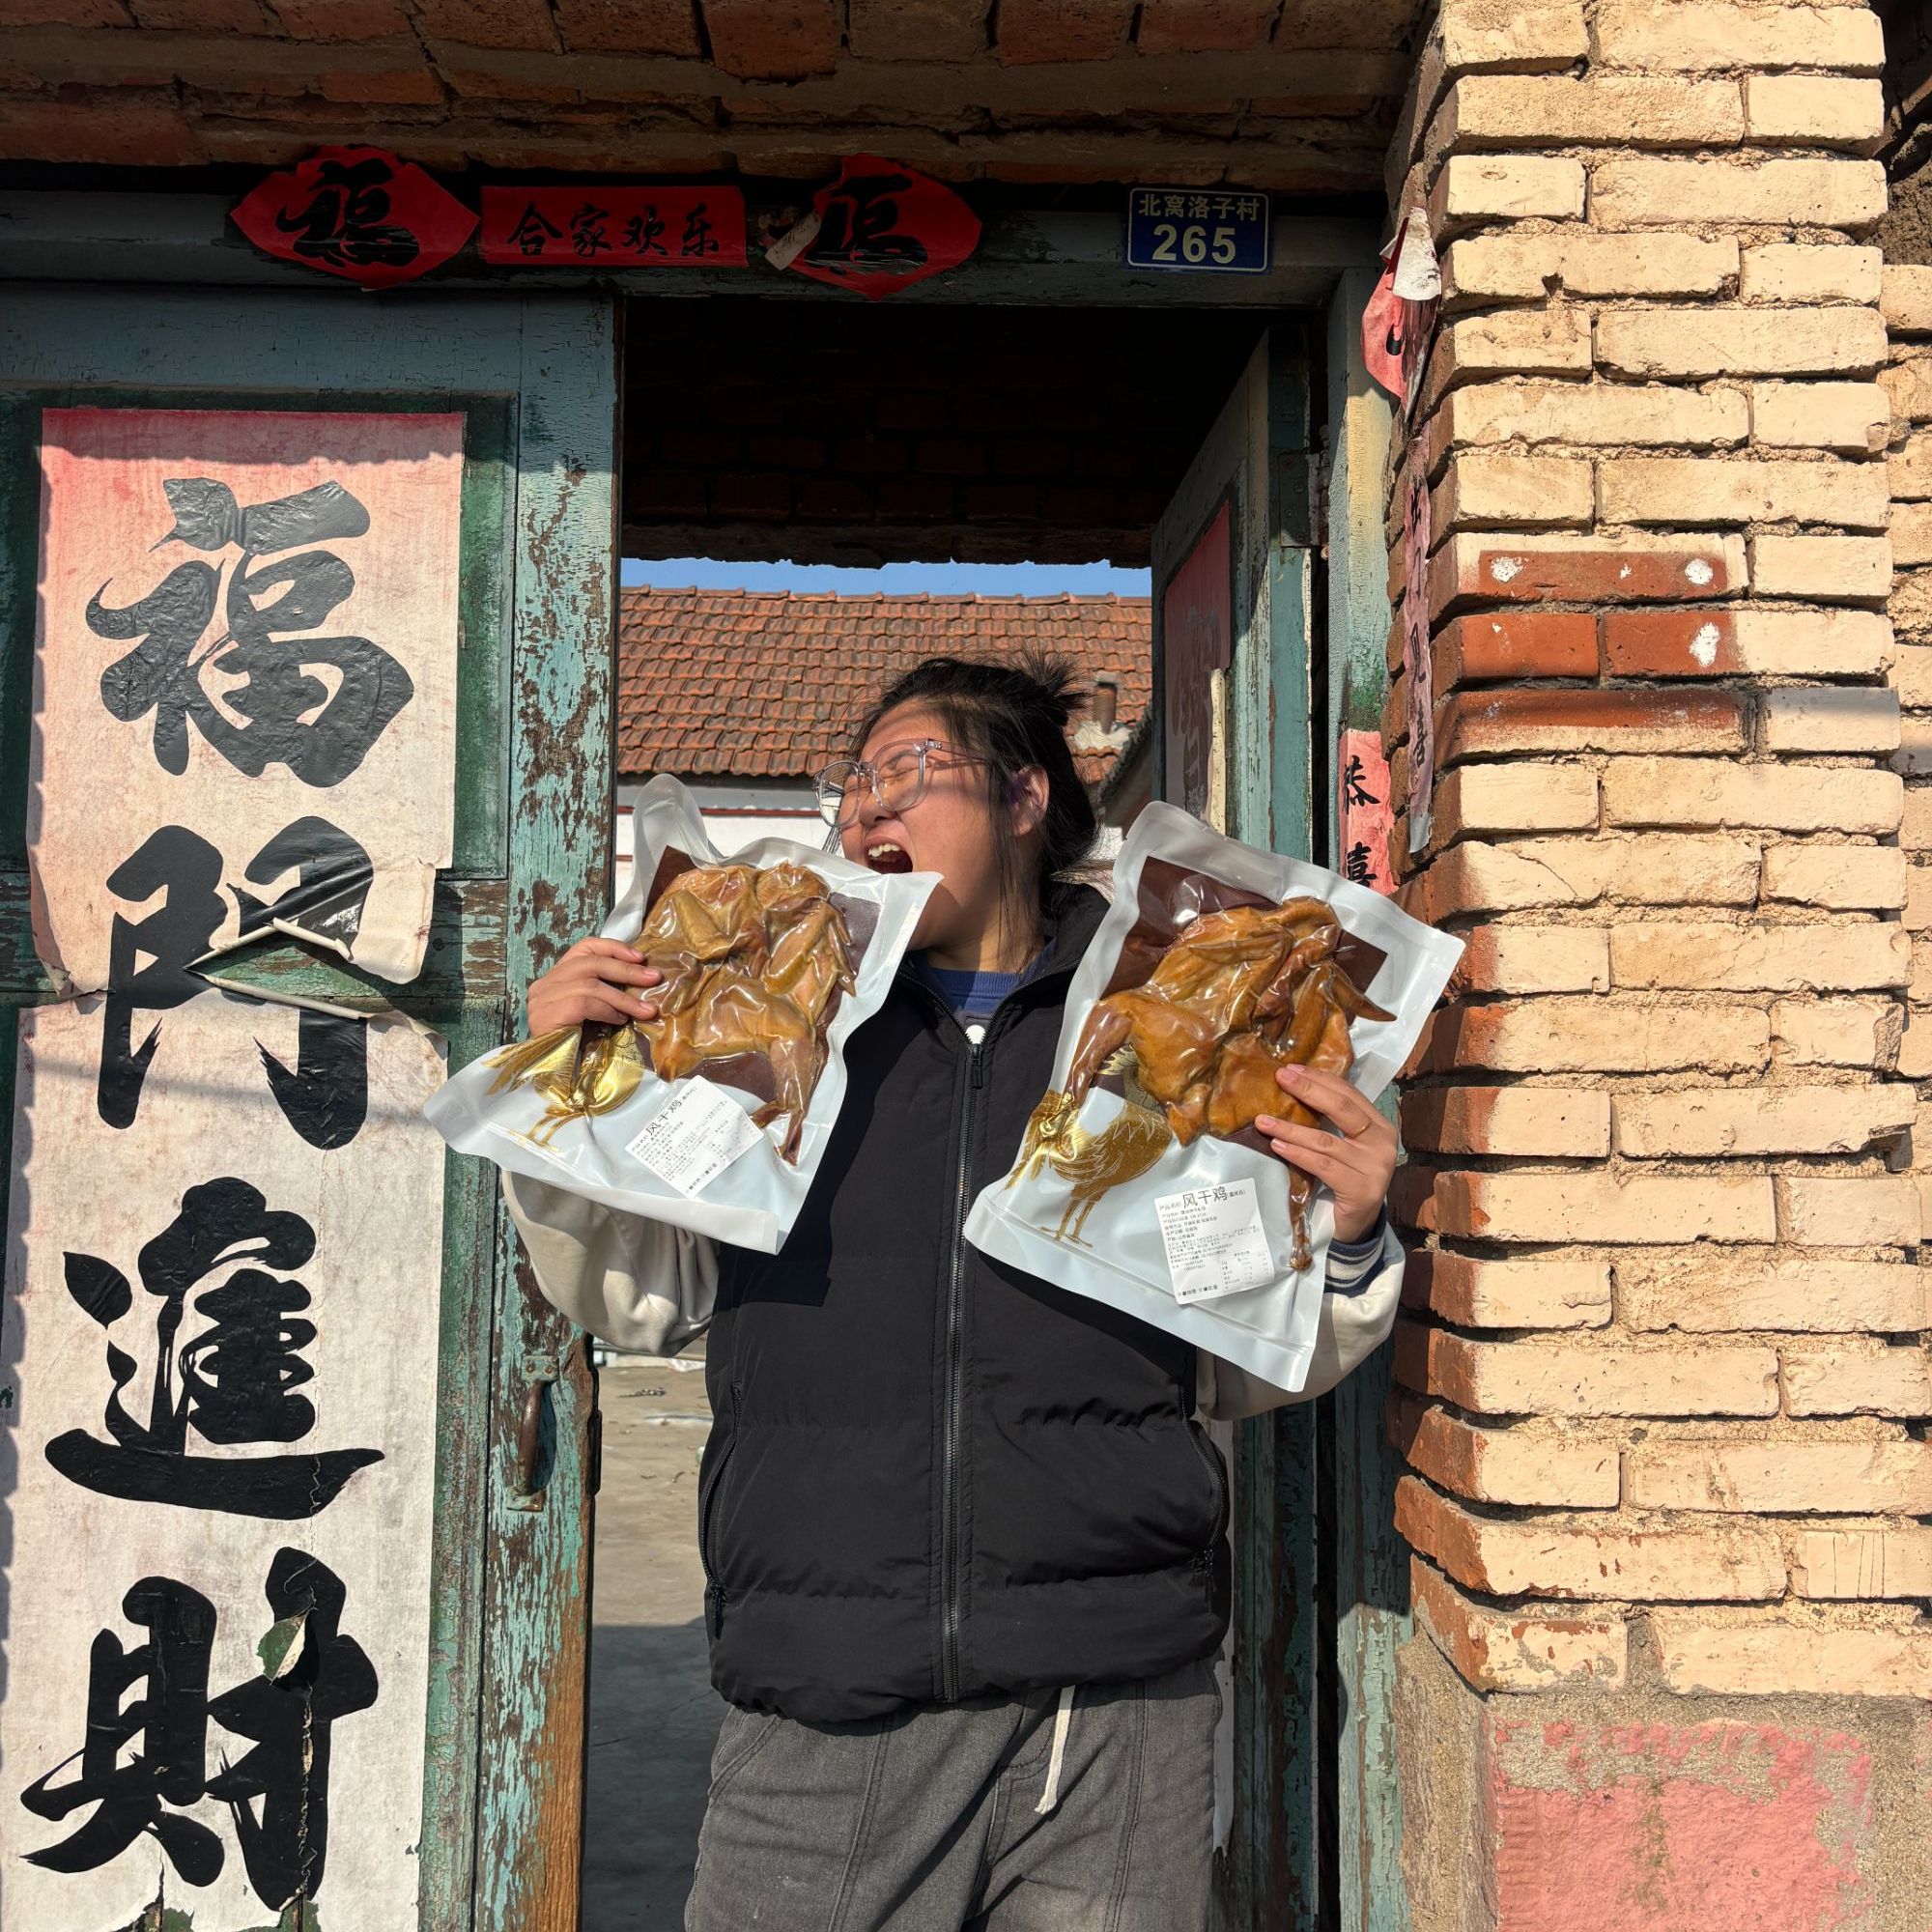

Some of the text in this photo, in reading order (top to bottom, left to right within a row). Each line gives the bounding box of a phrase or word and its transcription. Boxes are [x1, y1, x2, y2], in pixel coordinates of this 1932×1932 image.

[276, 158, 419, 267] 福
[1138, 193, 1260, 221] 北窝洛子村
[507, 201, 720, 258] 合家欢乐
[1151, 223, 1236, 265] 265
[645, 1099, 682, 1136] 风干鸡
[1183, 1185, 1228, 1208] 风干鸡
